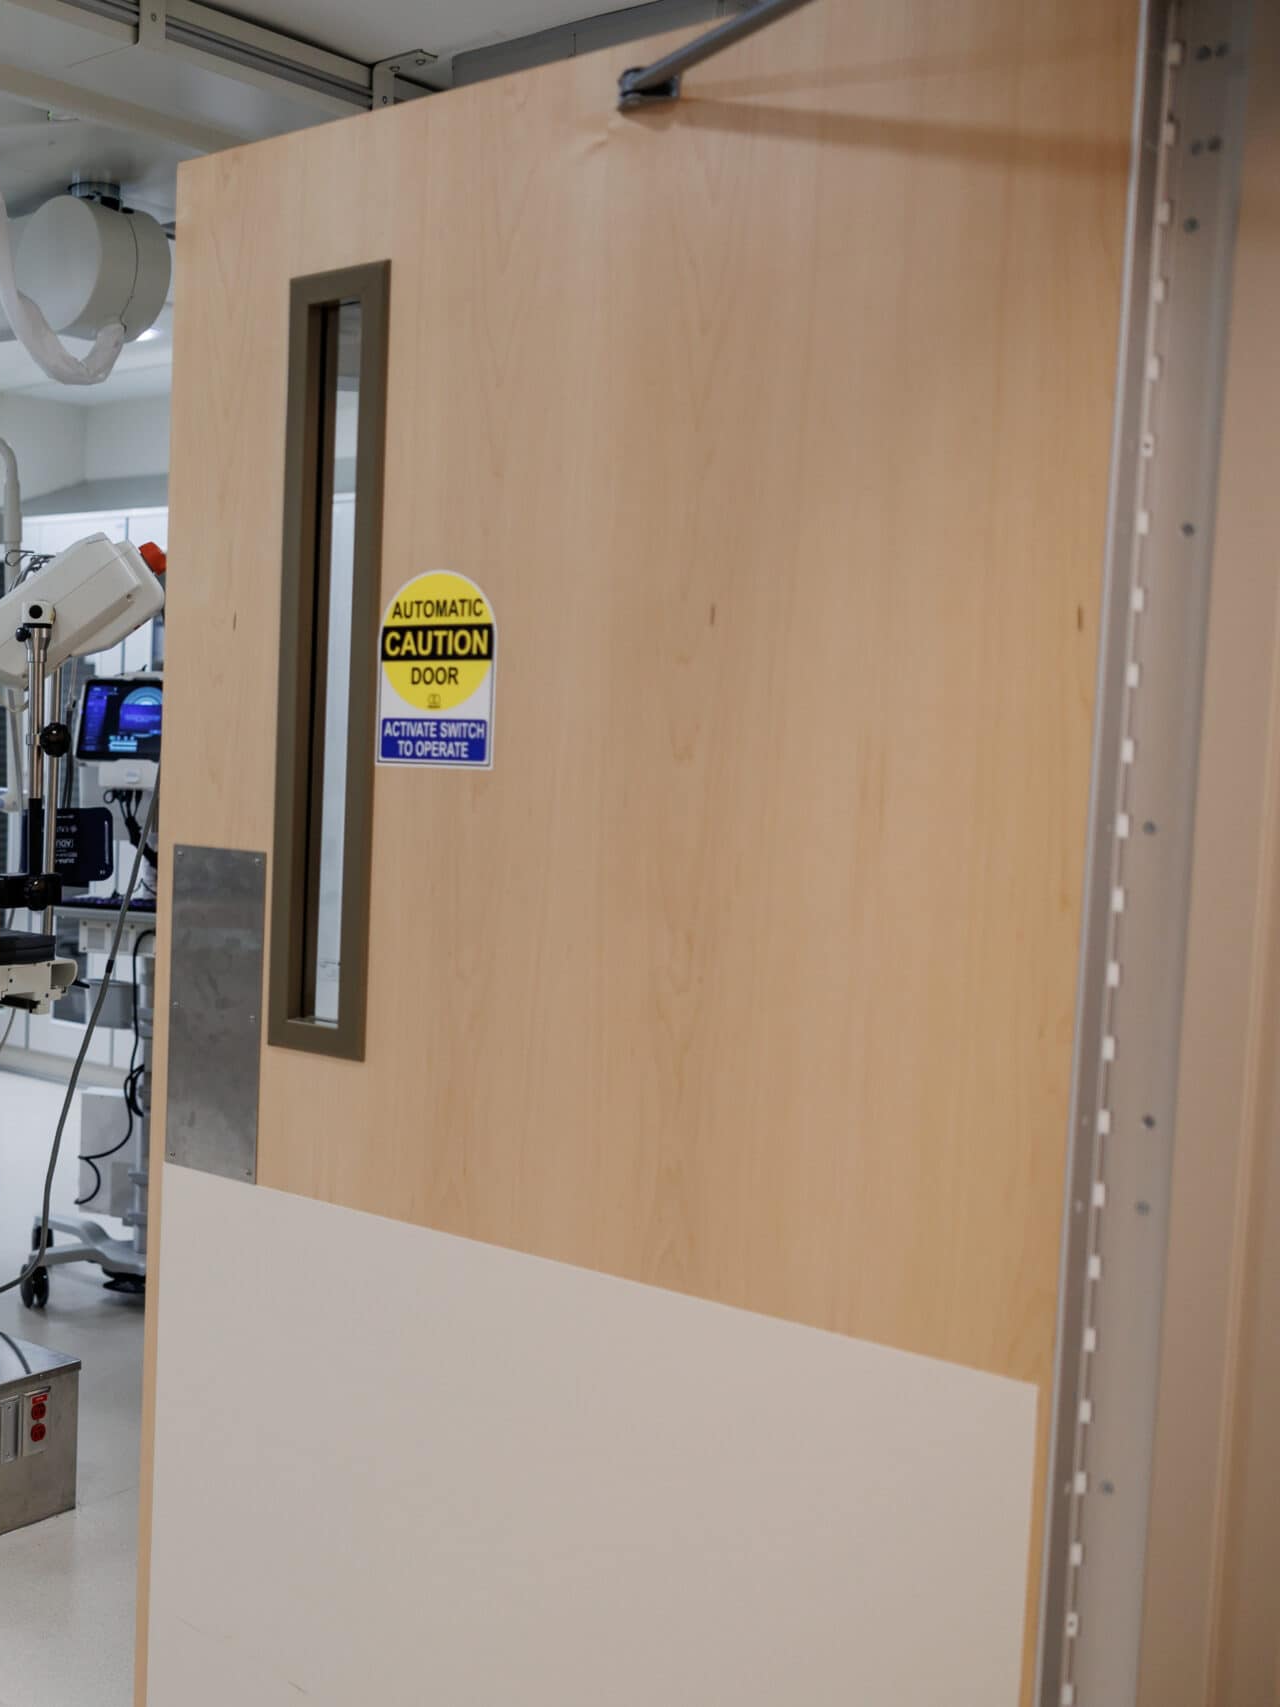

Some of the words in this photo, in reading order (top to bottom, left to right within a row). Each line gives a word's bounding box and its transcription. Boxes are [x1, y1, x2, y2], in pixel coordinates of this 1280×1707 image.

[392, 599, 483, 619] AUTOMATIC
[385, 629, 489, 656] CAUTION
[411, 667, 459, 685] DOOR
[384, 721, 438, 738] ACTIVATE
[440, 722, 485, 739] SWITCH
[397, 740, 413, 757] TO
[416, 740, 469, 758] OPERATE
